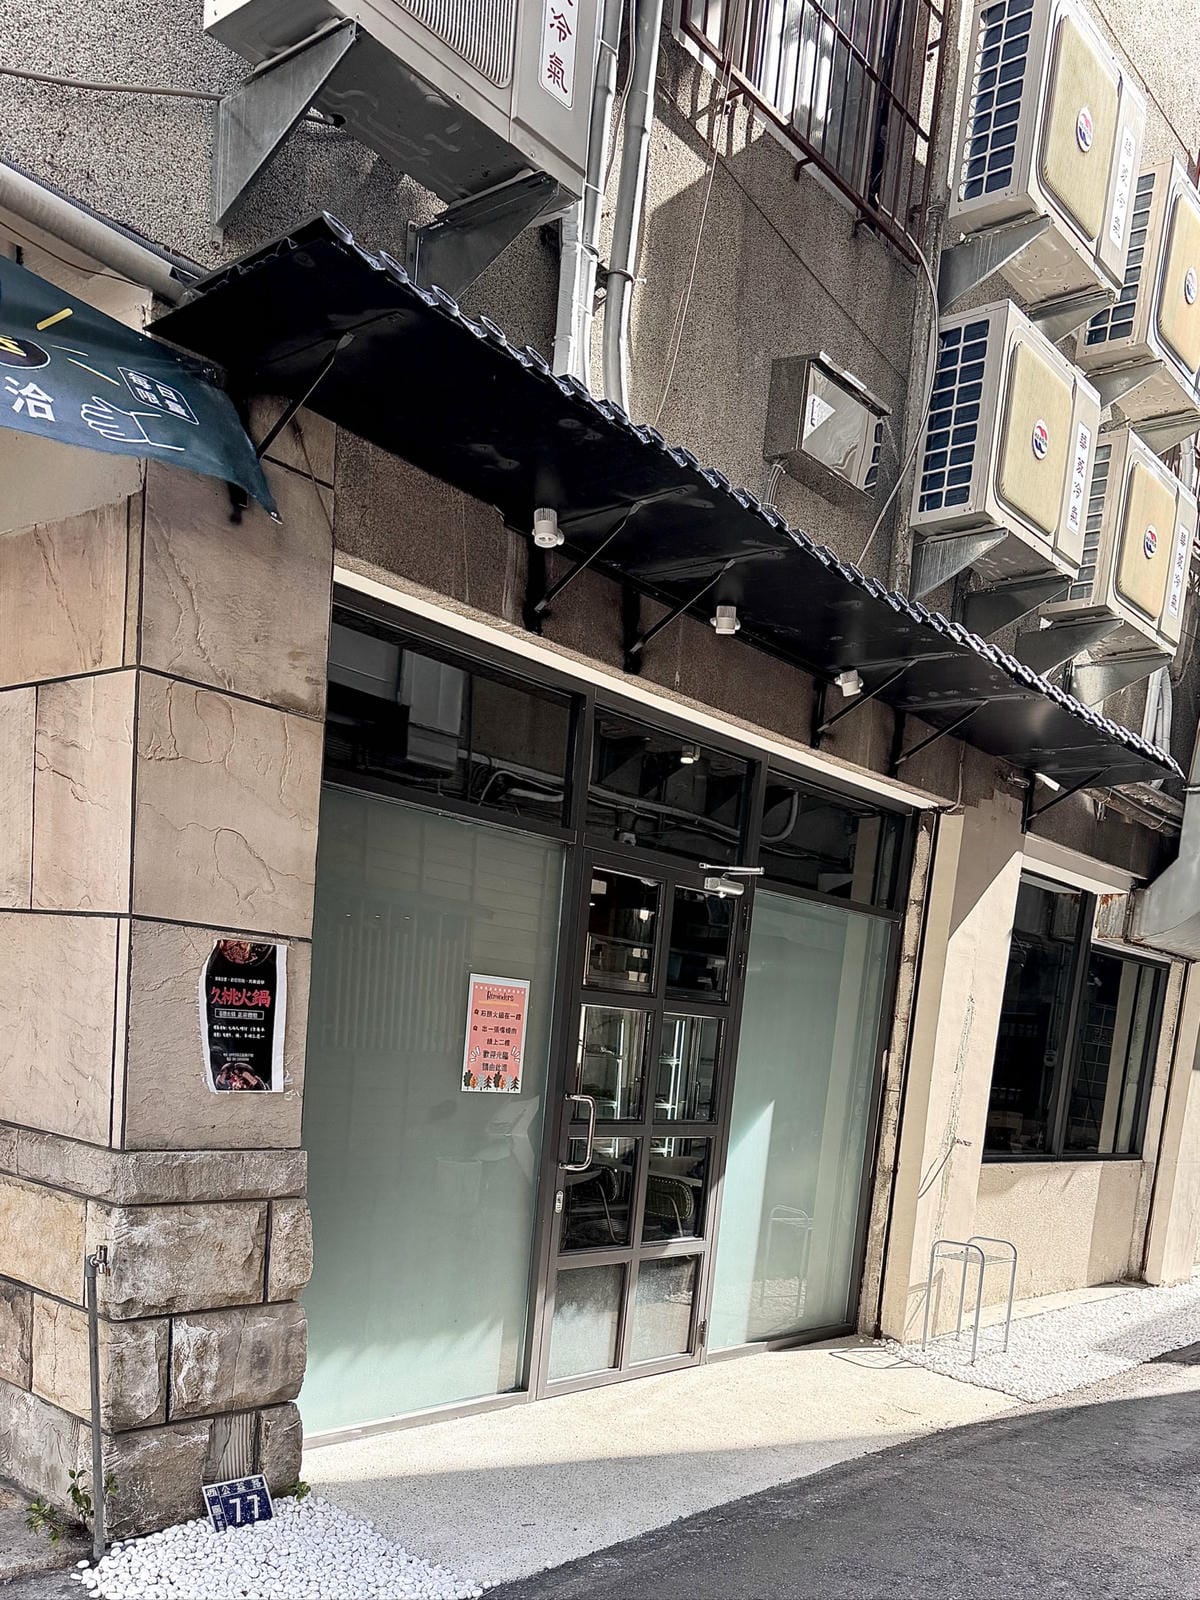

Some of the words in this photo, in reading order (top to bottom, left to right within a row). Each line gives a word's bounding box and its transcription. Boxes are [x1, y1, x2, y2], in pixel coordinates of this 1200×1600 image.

[547, 0, 573, 93] 冷氣
[5, 376, 55, 422] 洽
[210, 986, 271, 1008] 久桃火鍋
[486, 991, 514, 1001] Reminders
[483, 1050, 508, 1060] 歡迎光臨
[229, 1494, 260, 1522] 77
